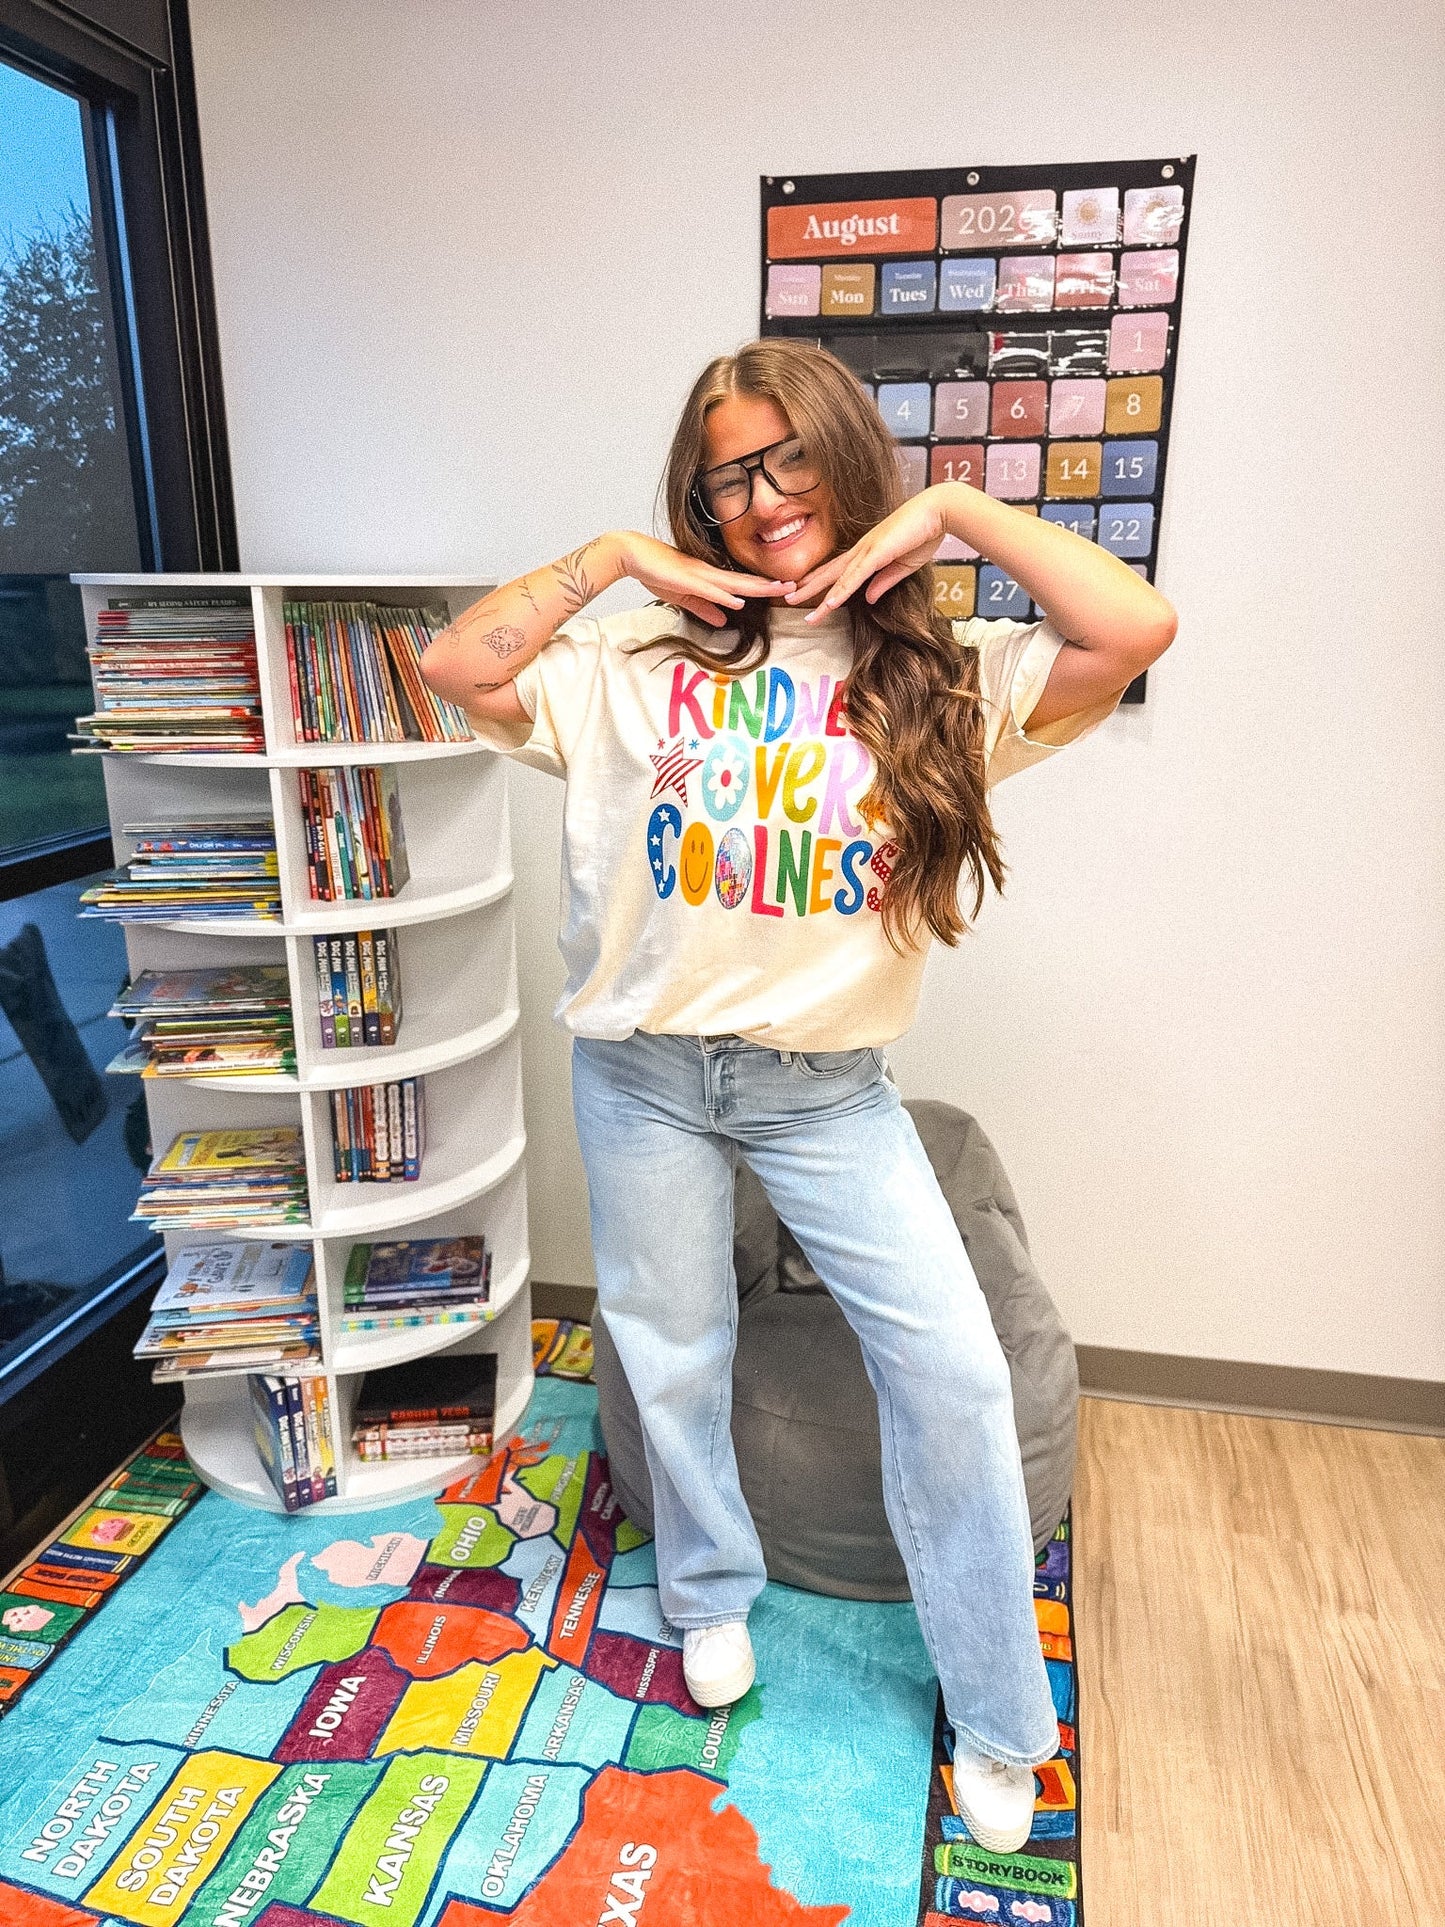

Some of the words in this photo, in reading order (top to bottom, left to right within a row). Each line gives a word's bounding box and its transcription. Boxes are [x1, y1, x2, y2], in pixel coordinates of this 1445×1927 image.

[803, 211, 901, 245] August
[778, 292, 808, 305] Sun
[830, 290, 865, 304] Mon
[890, 288, 927, 302] Tues
[950, 284, 985, 299] Wed
[1133, 330, 1144, 353] 1
[896, 400, 912, 421] 4
[956, 400, 969, 419] 5
[1071, 395, 1084, 415] 7
[1125, 394, 1141, 416] 8
[943, 460, 972, 482] 12
[1000, 459, 1028, 482] 13
[1060, 458, 1088, 480] 14
[1114, 457, 1143, 479] 15
[1109, 520, 1140, 541] 22
[936, 581, 963, 602] 26
[989, 581, 1018, 601] 27
[646, 803, 900, 918] COOLNESS
[449, 1516, 488, 1563] OHIO
[415, 1613, 447, 1666] ILLINOIS
[558, 1571, 602, 1640] TENNESSEE
[269, 1610, 318, 1673] WISCONSIN
[183, 1678, 241, 1750] MINNESOTA
[308, 1673, 367, 1741] IOWA
[450, 1671, 502, 1749] MISSOURI
[542, 1674, 586, 1762] ARKANSAS
[698, 1703, 734, 1770] LOUISIA
[21, 1759, 121, 1864] NORTH
[52, 1760, 161, 1879] DAKOTA
[115, 1785, 208, 1893] SOUTH
[362, 1772, 451, 1908] KANSAS
[480, 1772, 550, 1899] OKLAHOMA
[147, 1785, 248, 1907] DAKOTA
[212, 1770, 333, 1927] NEBRASKA
[951, 1855, 1067, 1886] STORYBOOK
[597, 1840, 659, 1927] XAS
